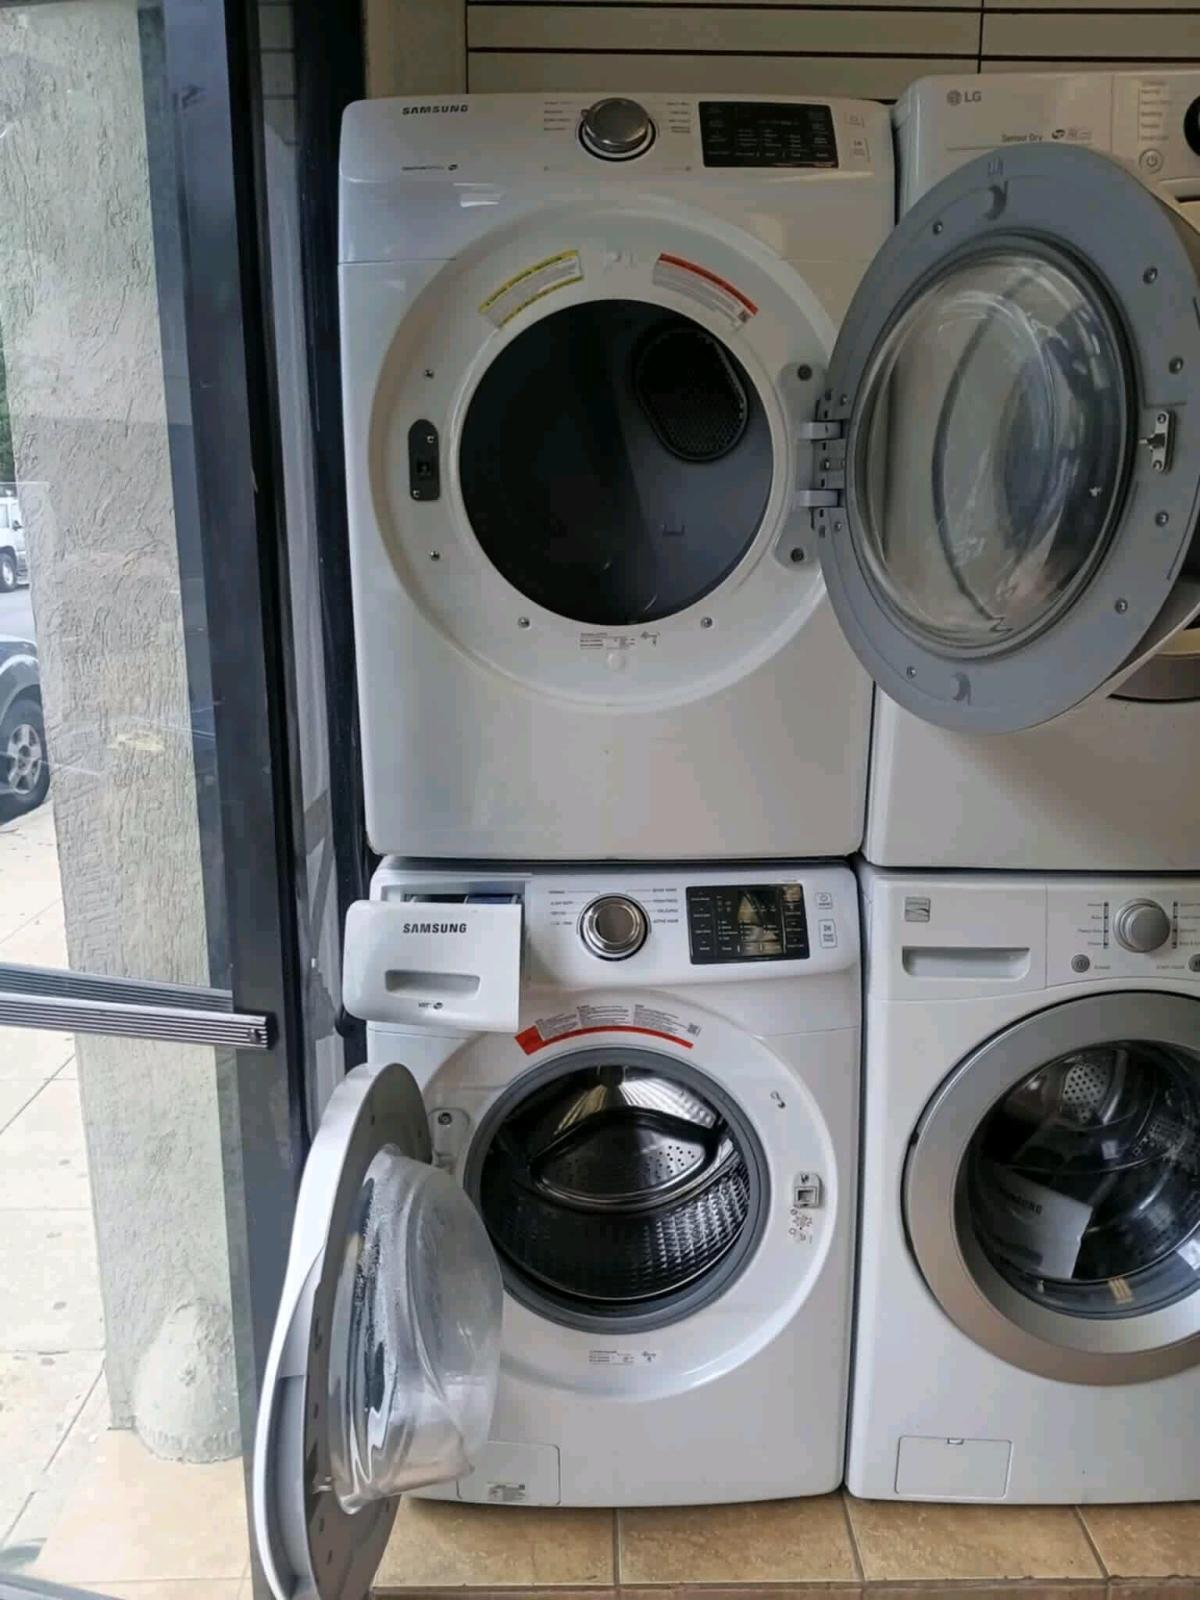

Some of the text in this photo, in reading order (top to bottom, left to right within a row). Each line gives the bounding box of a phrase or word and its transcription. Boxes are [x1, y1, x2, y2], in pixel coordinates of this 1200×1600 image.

[964, 91, 982, 102] LG
[402, 104, 468, 115] SAMSUNG
[403, 922, 468, 934] SAMSUNG
